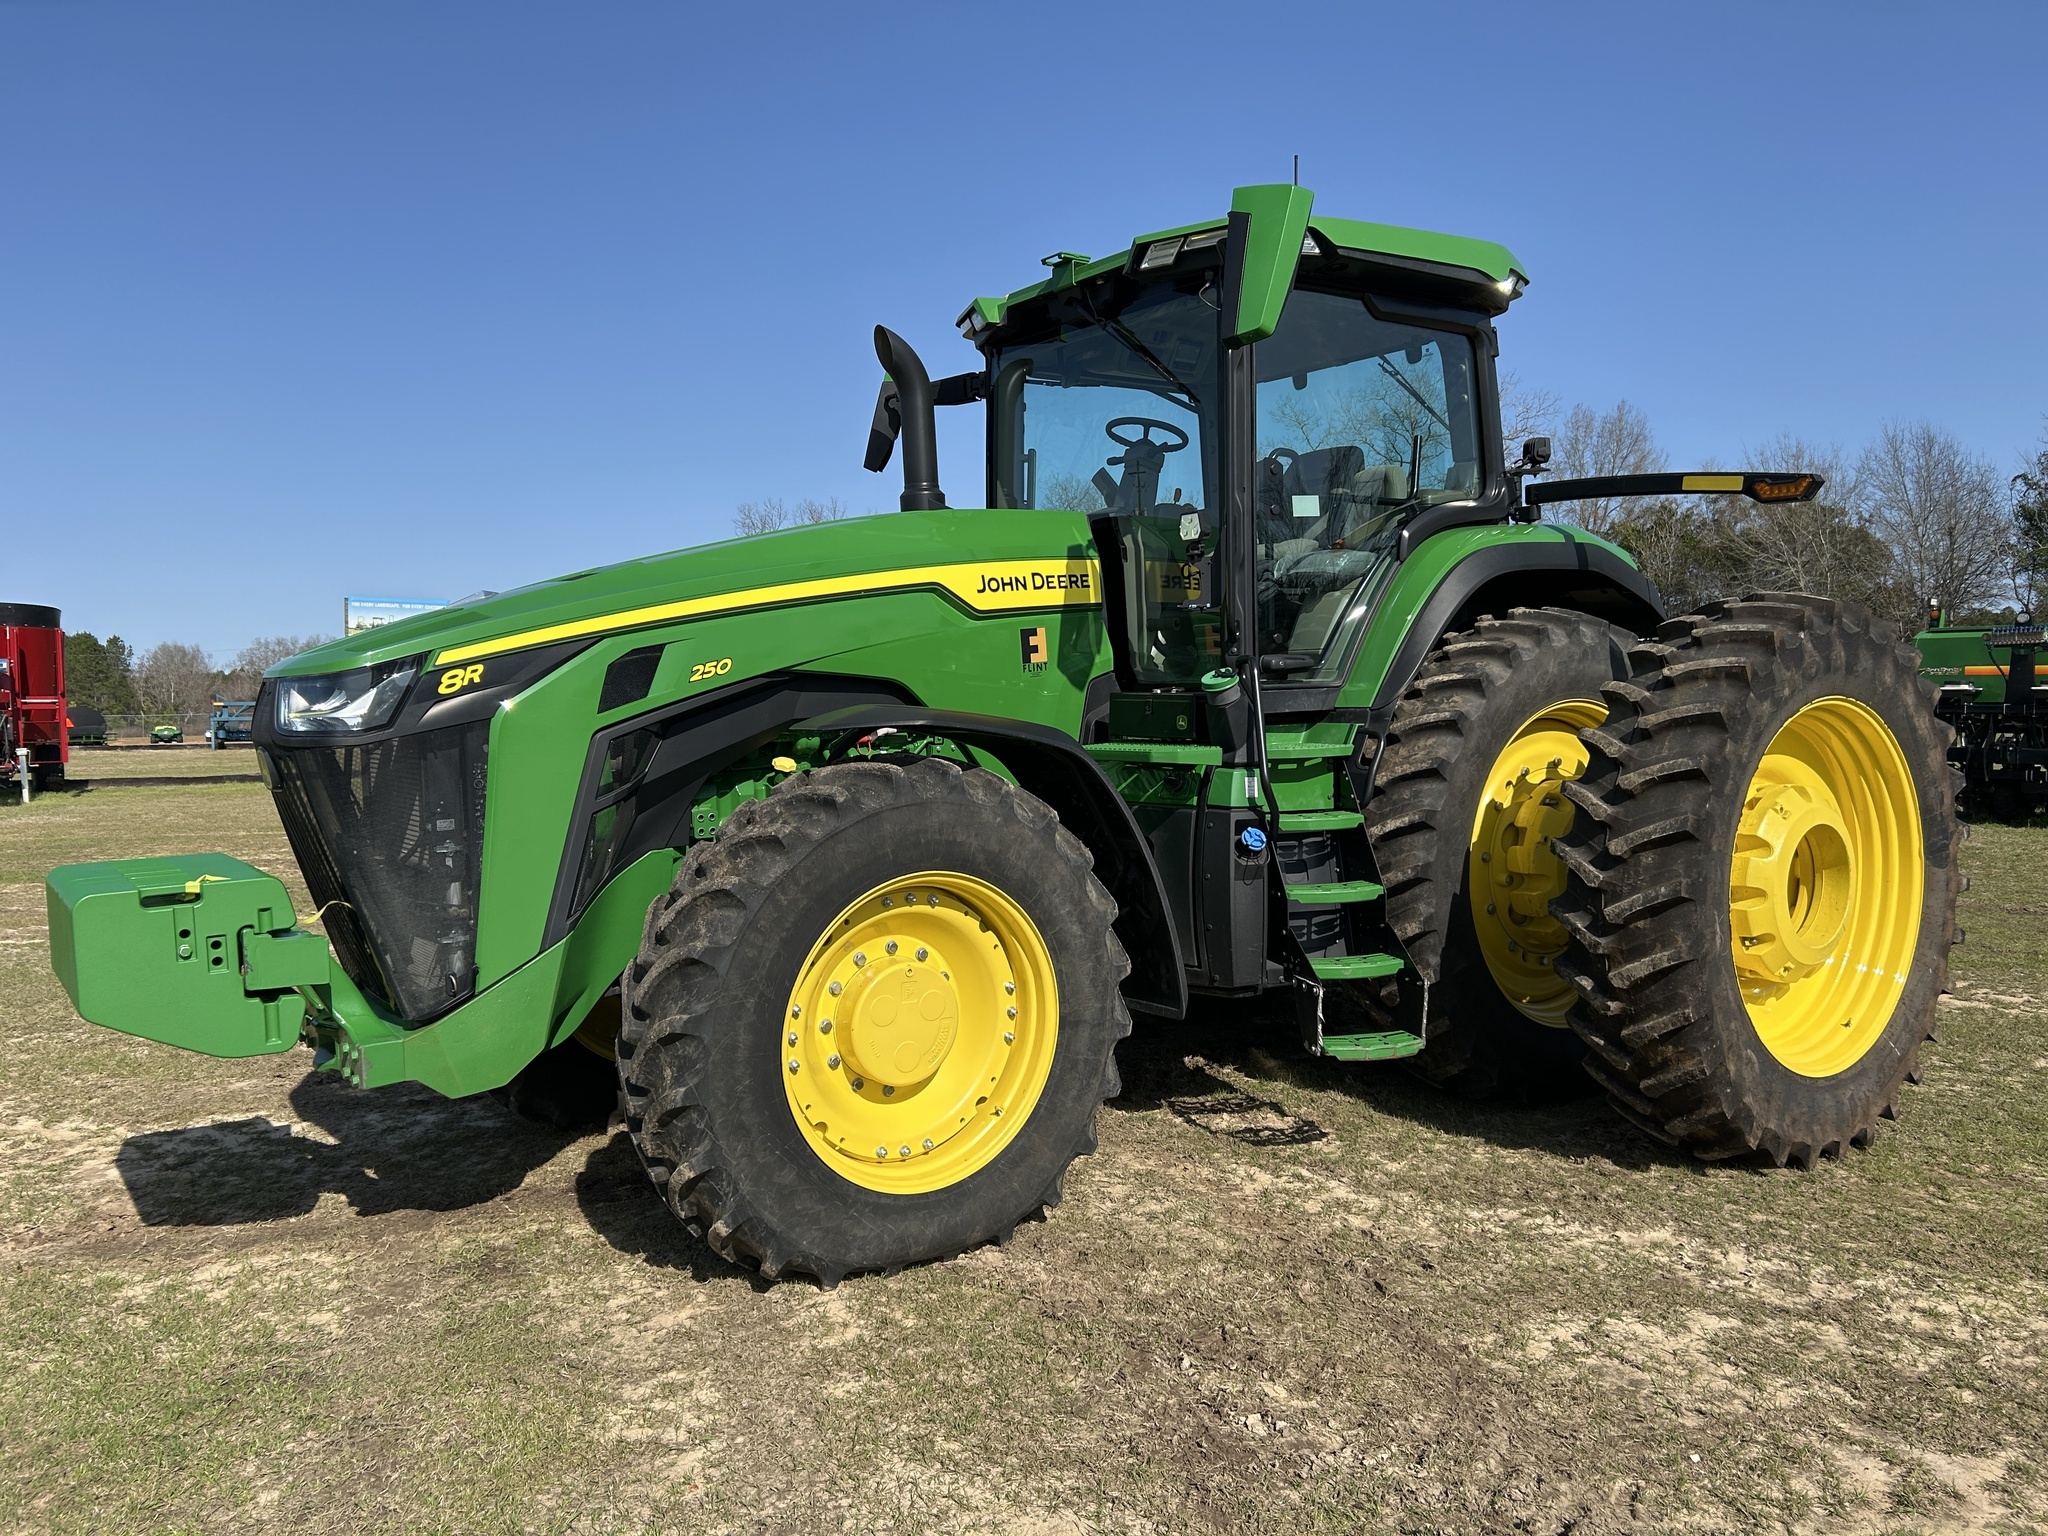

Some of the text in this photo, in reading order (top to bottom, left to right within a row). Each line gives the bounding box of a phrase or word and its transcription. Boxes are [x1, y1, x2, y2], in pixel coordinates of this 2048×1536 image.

[977, 572, 1091, 594] JOHN DEERE
[437, 663, 485, 695] 8R
[689, 657, 733, 682] 250
[1022, 662, 1048, 674] FLINT
